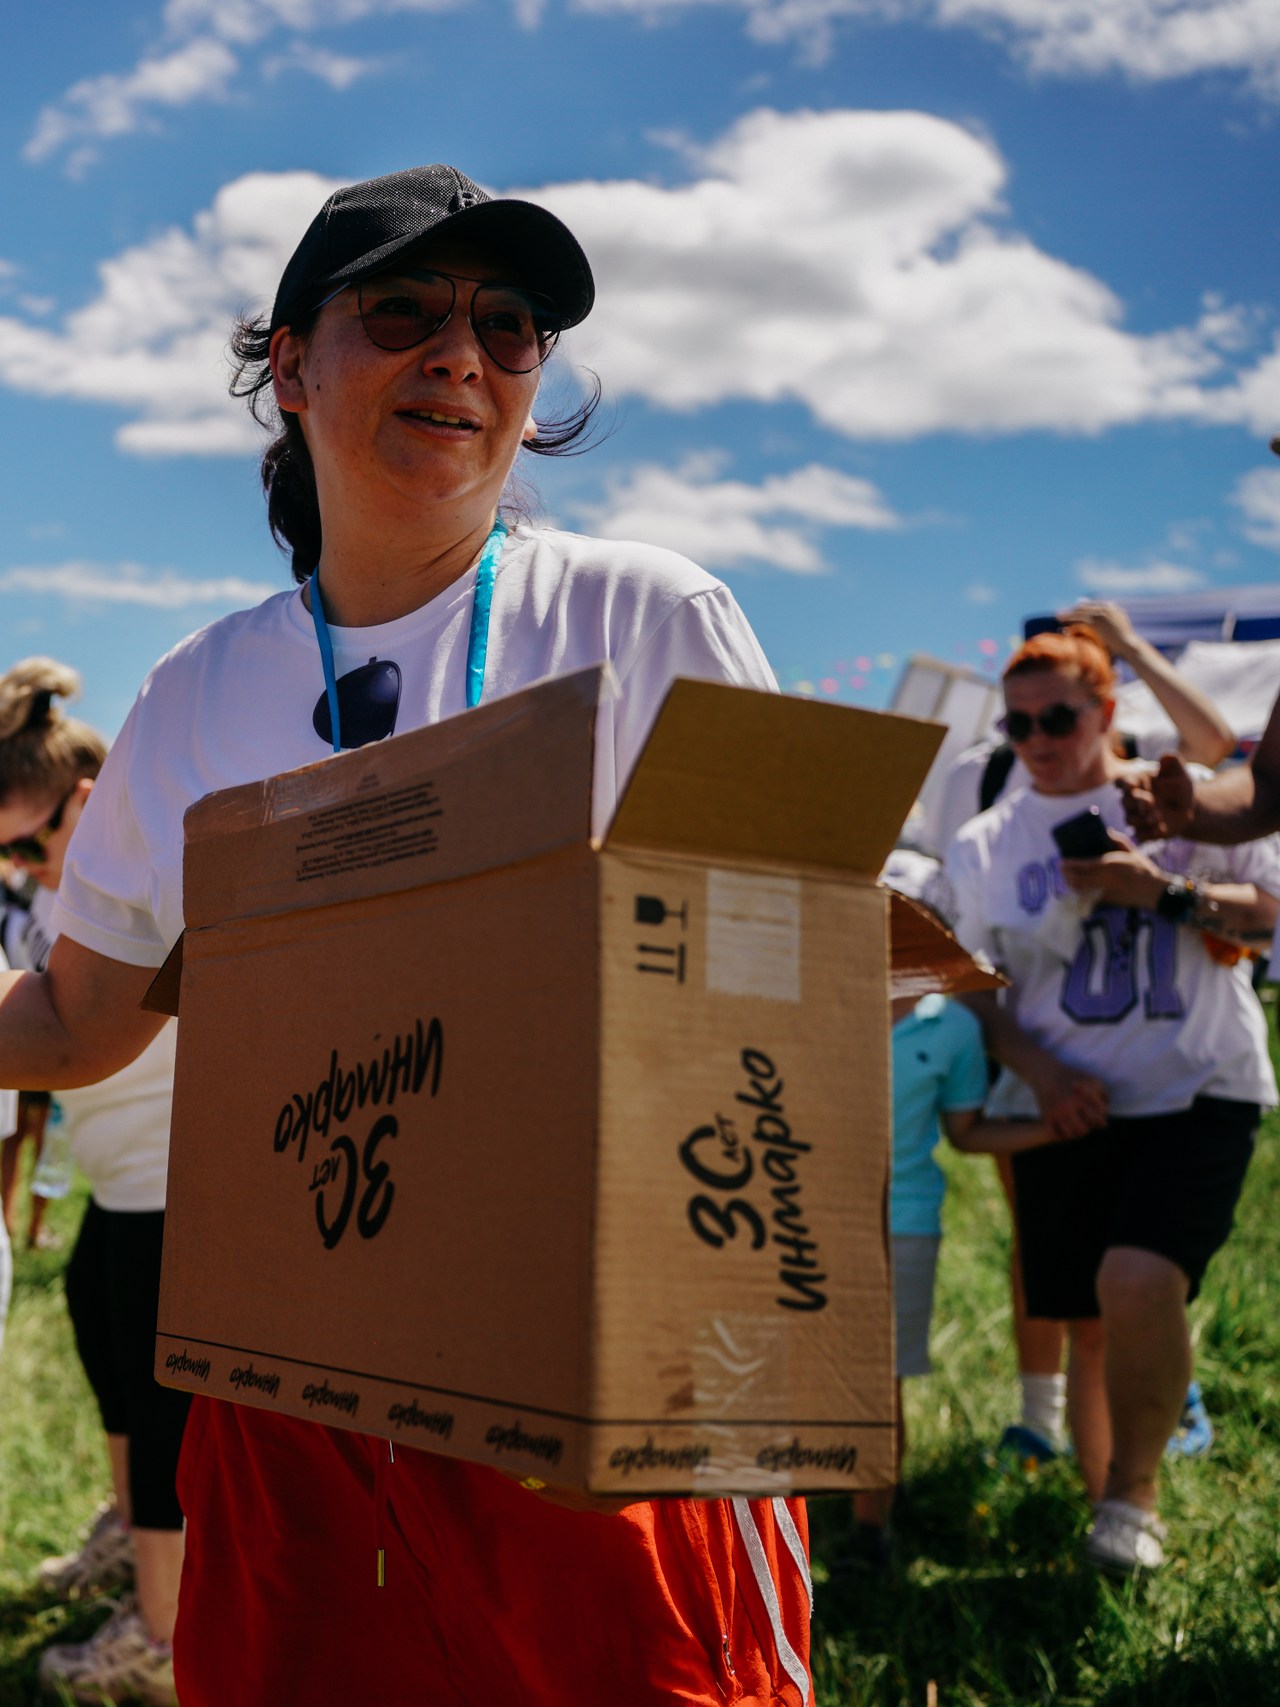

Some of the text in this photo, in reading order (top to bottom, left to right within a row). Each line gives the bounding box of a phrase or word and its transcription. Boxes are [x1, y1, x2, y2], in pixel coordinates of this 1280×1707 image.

[273, 1018, 444, 1164] Инмарко
[308, 1113, 399, 1251] 30 лет
[677, 1112, 767, 1251] 30 лет
[734, 1048, 829, 1313] Инмарко
[165, 1348, 211, 1383] Инмарко
[229, 1363, 281, 1399] Инмарко
[301, 1379, 361, 1418] Инмарко
